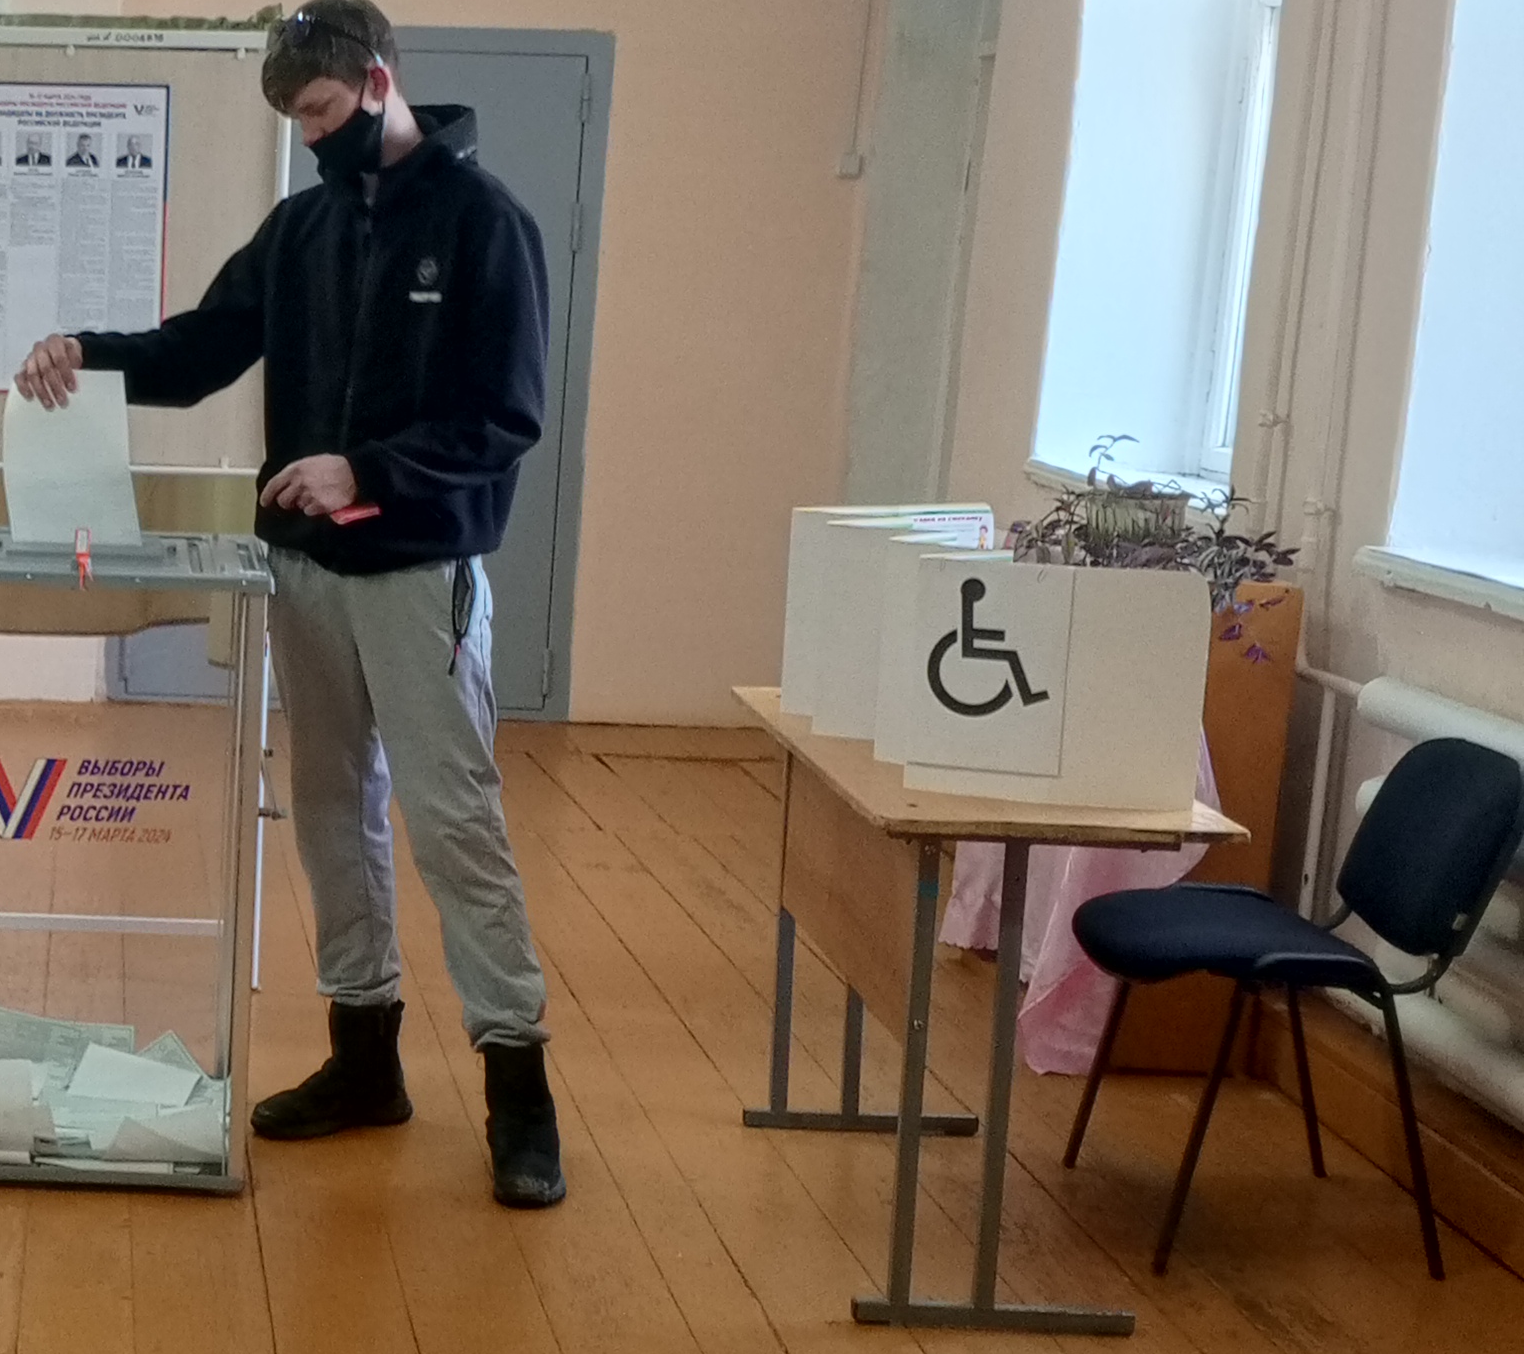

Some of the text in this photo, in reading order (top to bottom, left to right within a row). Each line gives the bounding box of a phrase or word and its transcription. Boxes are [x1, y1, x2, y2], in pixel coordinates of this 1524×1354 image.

[77, 759, 165, 778] ВЫБОРЫ
[66, 782, 190, 802] ПРЕЗИДЕНТА
[56, 805, 136, 823] РОССИИ
[88, 827, 135, 843] МАРТА
[137, 828, 171, 843] 2024
